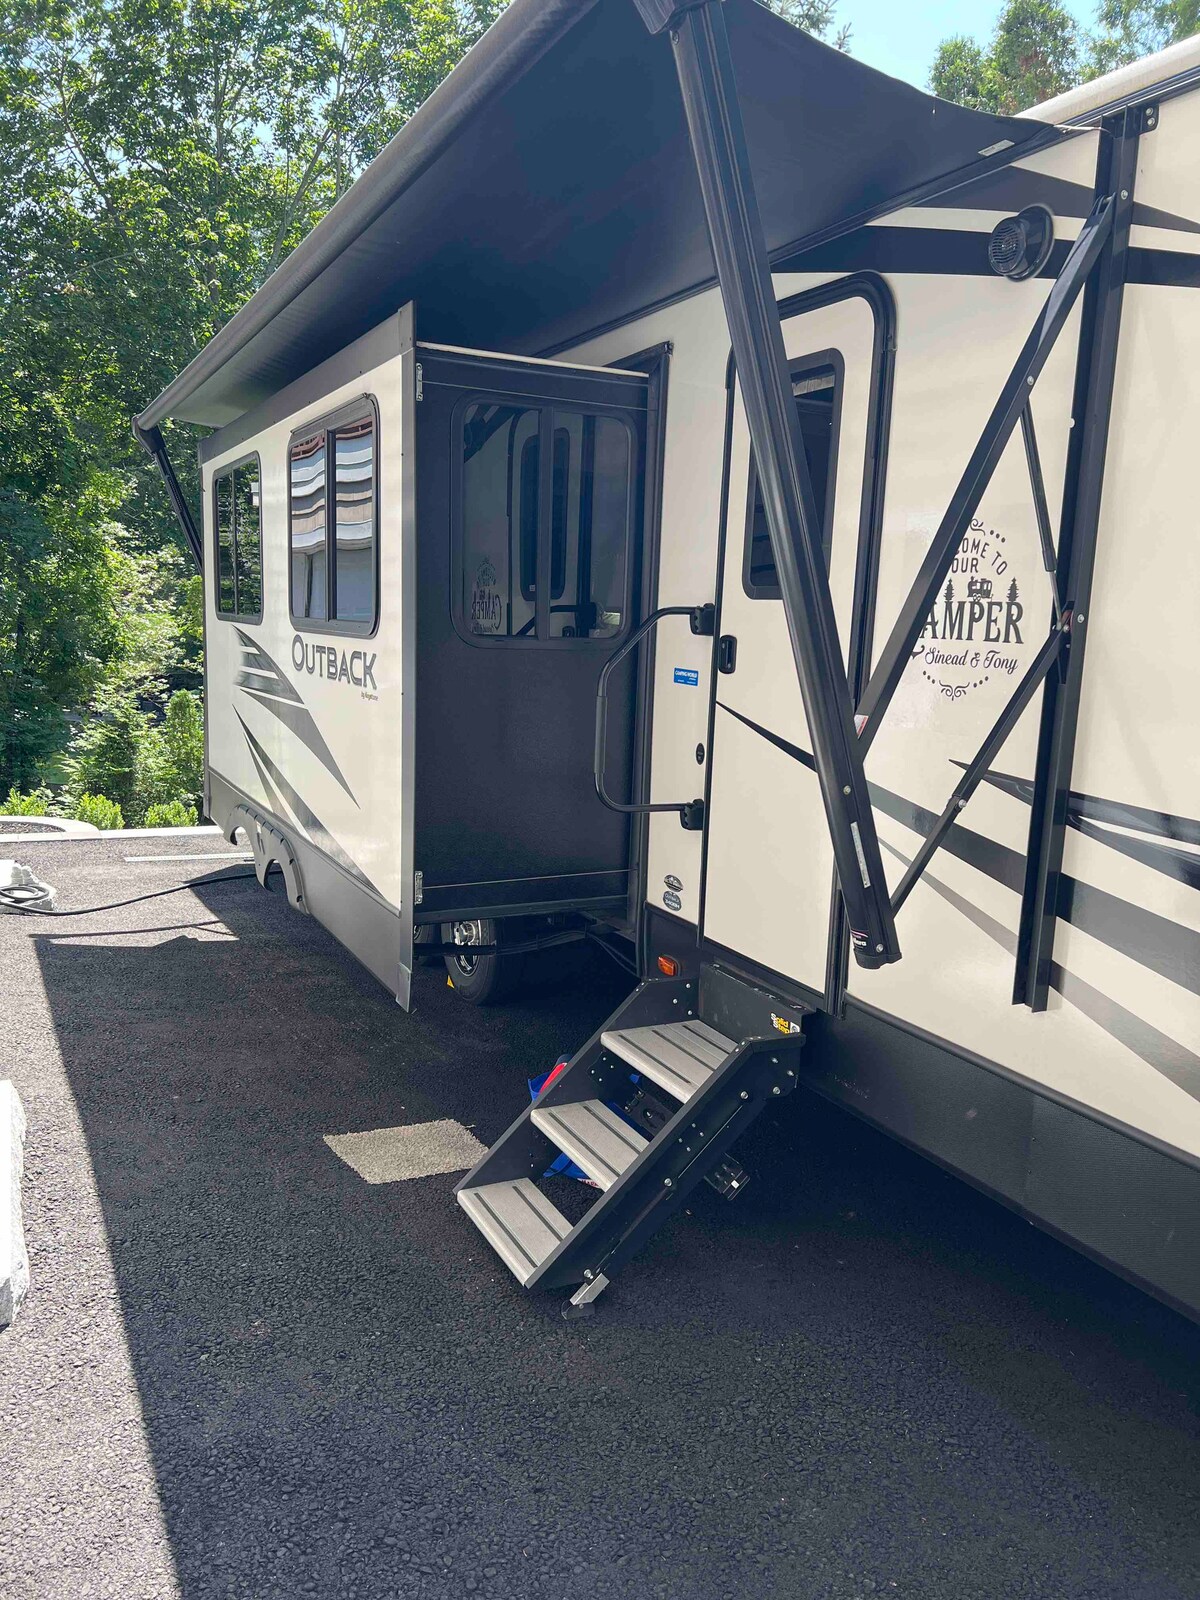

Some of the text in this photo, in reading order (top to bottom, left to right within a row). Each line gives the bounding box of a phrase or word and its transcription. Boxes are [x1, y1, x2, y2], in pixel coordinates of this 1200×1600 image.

[991, 551, 1008, 576] TO
[918, 600, 1024, 644] AMPER
[292, 634, 378, 690] OUTBACK
[925, 647, 1018, 675] Sinead & Tony
